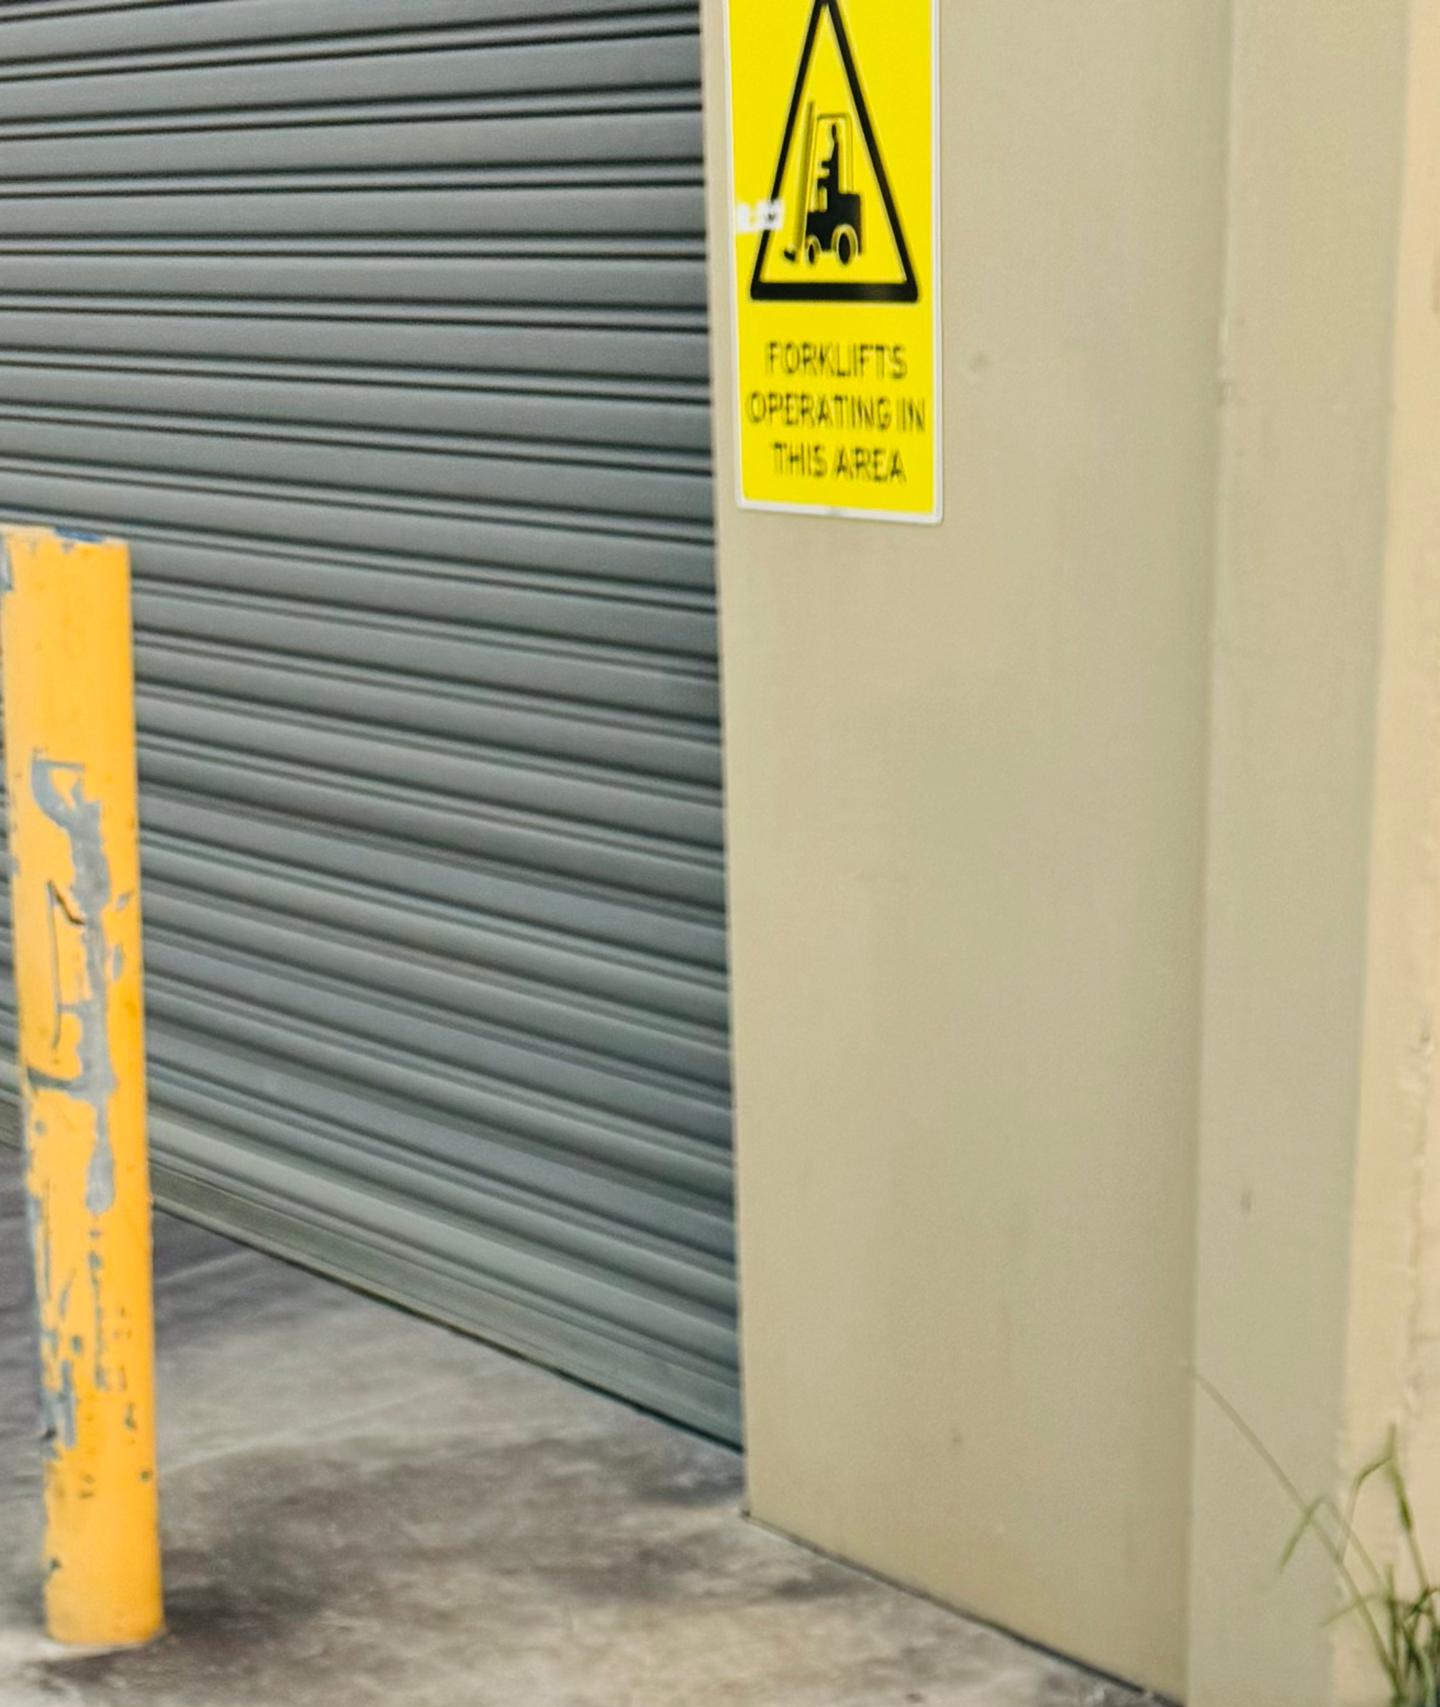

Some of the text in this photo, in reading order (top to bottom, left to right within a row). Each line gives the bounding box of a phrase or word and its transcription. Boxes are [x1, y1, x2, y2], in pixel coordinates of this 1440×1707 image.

[768, 341, 907, 379] FORKLIFTS
[749, 390, 926, 432] OPERATING IN
[772, 441, 907, 483] THIS AREA
